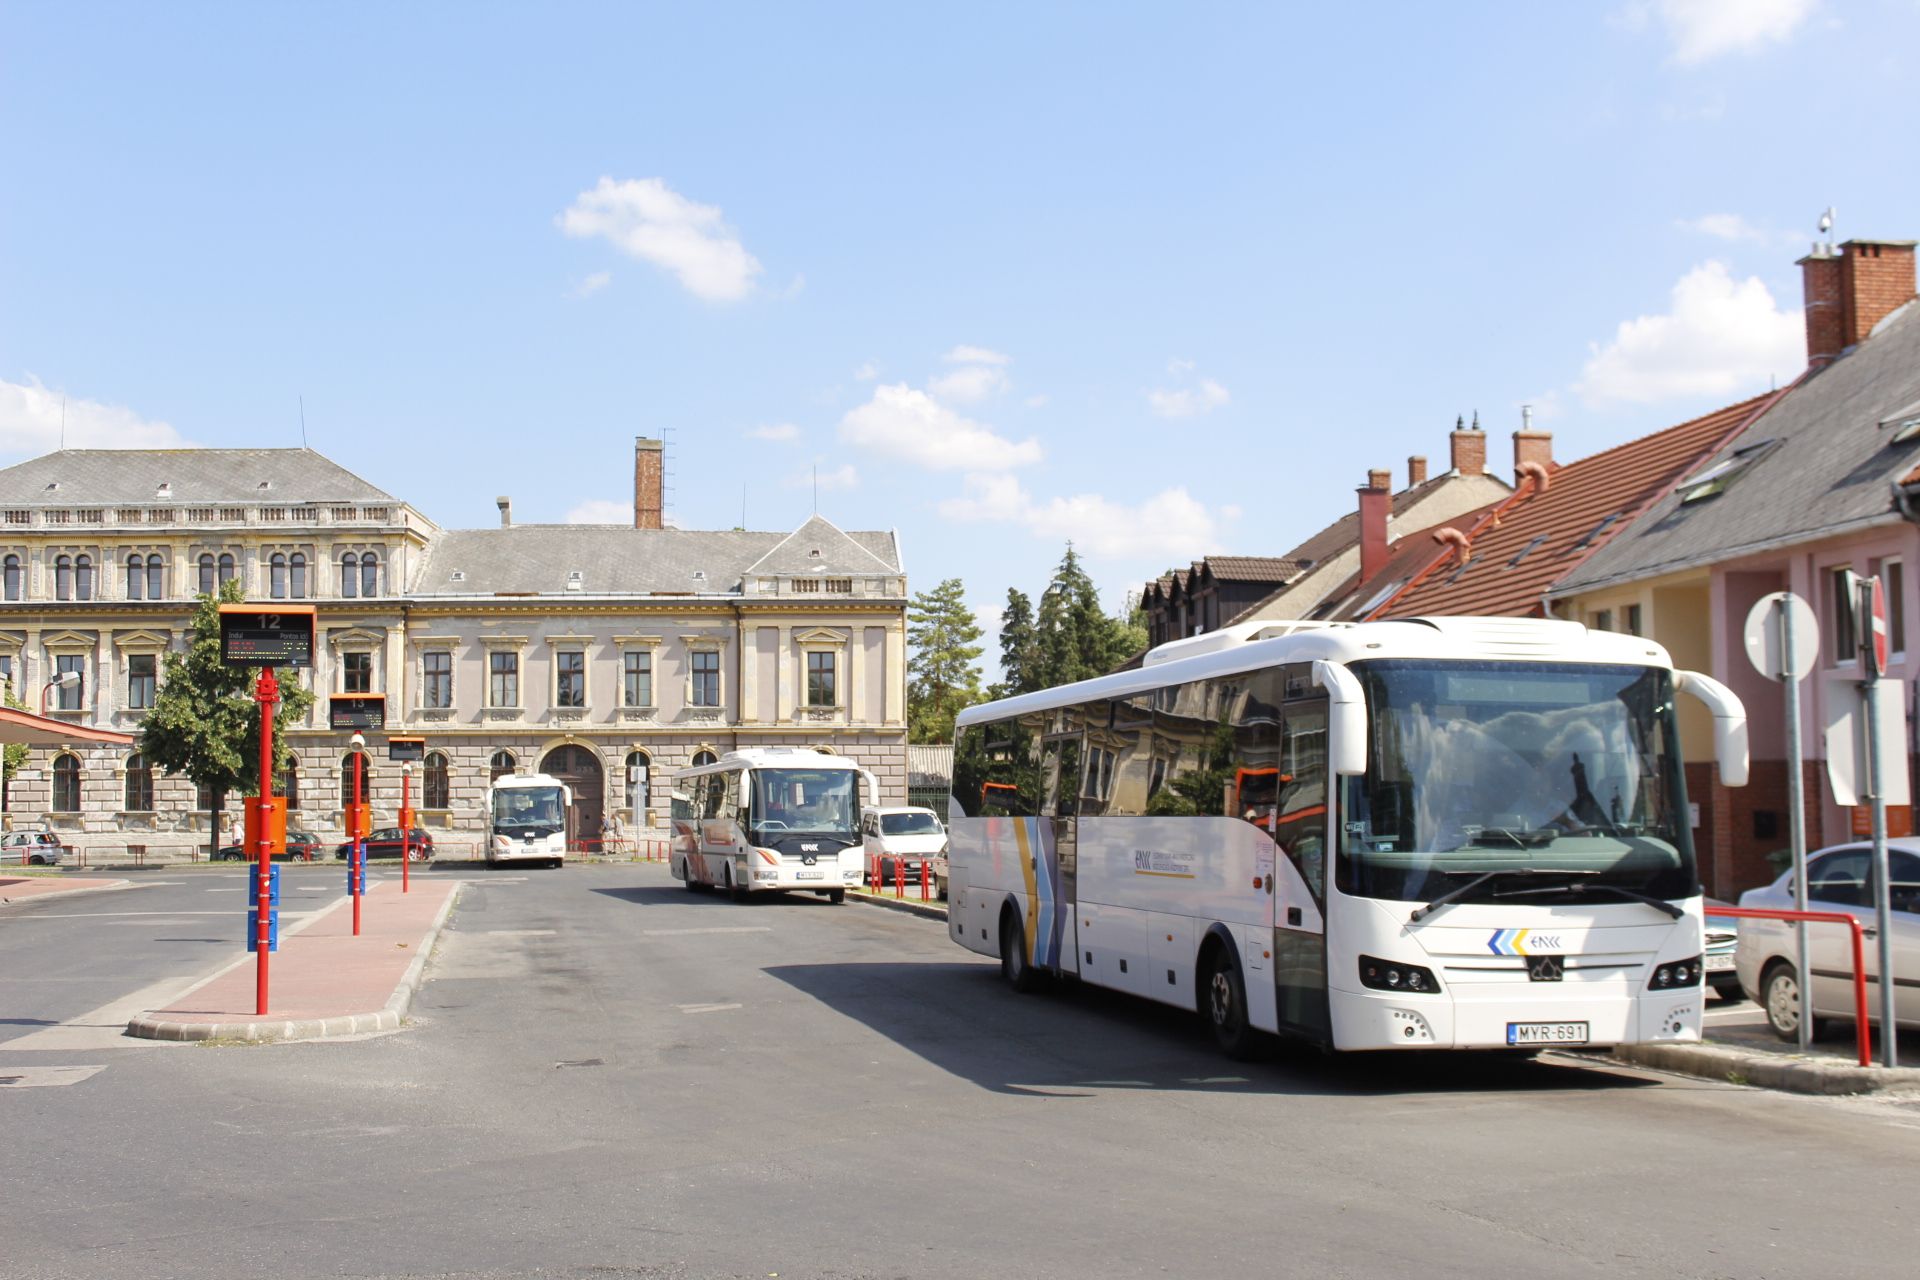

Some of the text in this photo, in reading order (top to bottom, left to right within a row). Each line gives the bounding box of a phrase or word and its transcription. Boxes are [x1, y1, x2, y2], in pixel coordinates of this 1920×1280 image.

[258, 614, 281, 629] 12
[351, 699, 365, 708] 13
[1519, 1026, 1582, 1040] MYR-691
